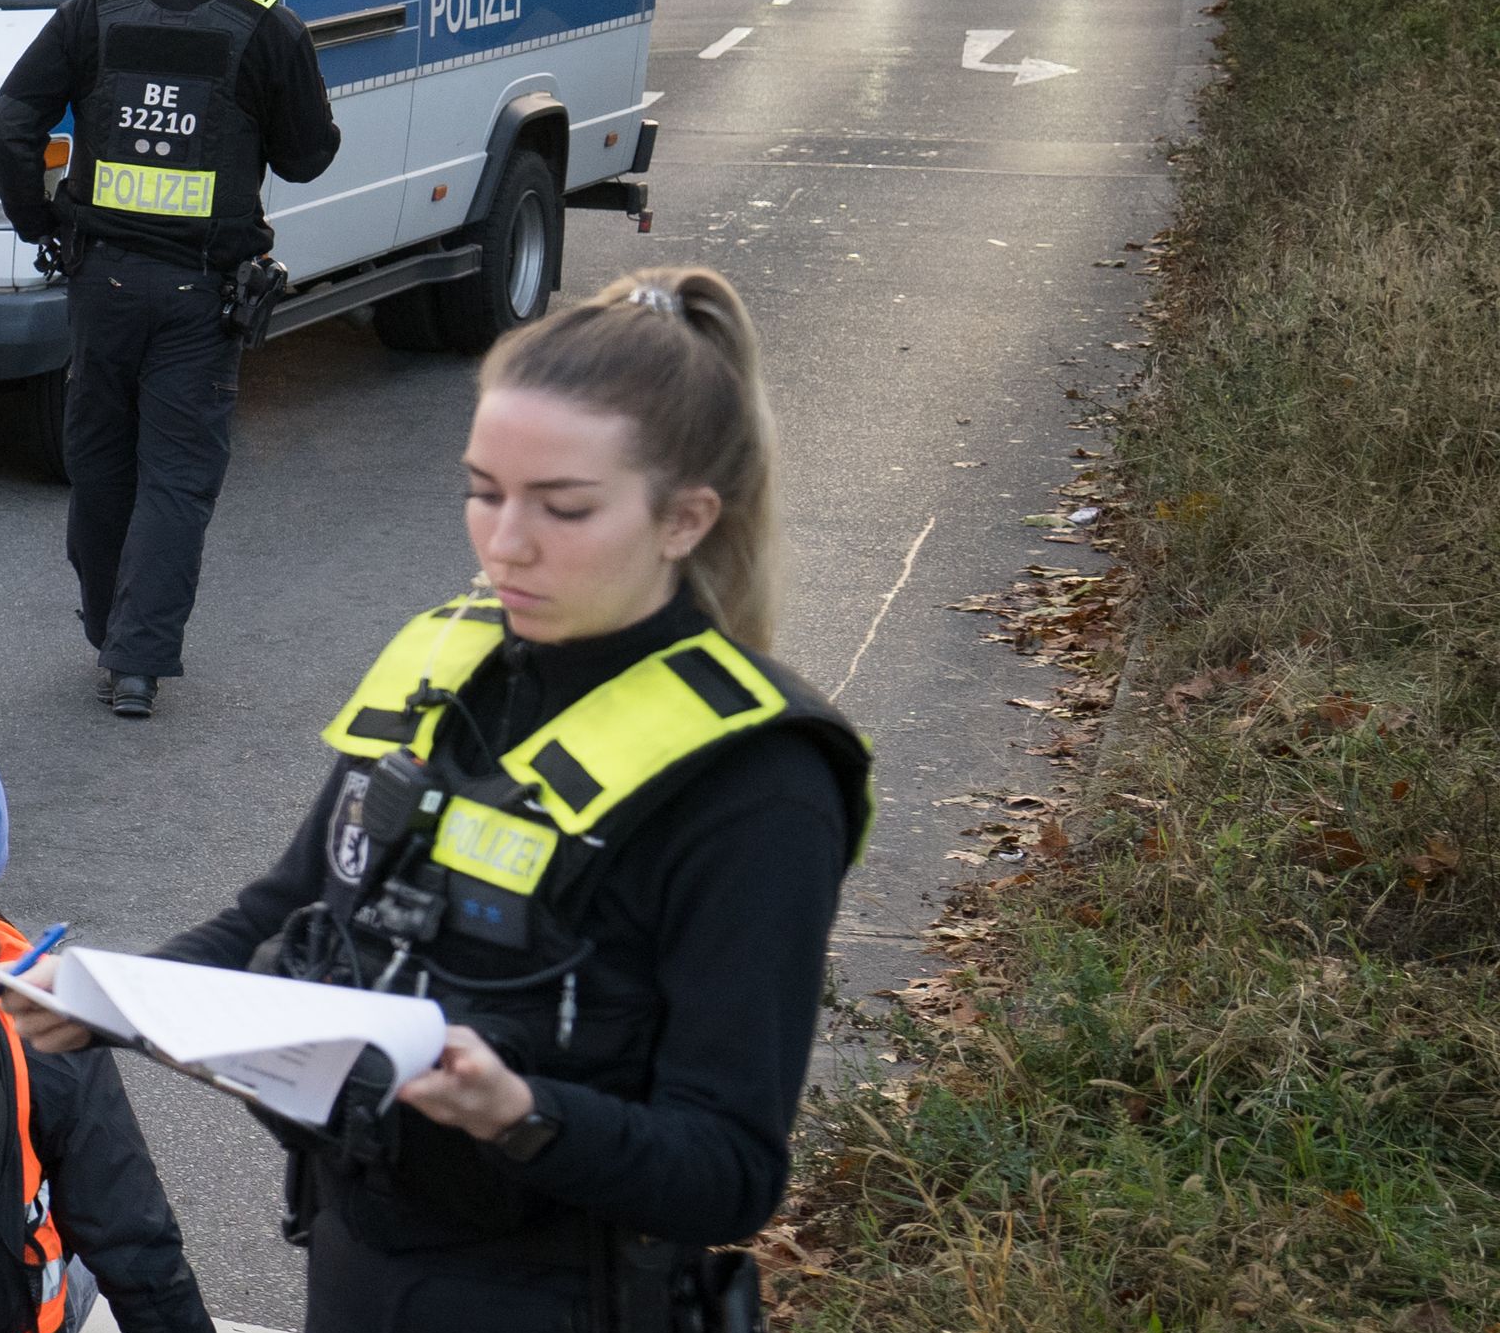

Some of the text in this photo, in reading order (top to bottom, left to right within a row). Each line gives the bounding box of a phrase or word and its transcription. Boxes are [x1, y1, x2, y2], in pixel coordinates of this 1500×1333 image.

[143, 83, 180, 108] BE
[118, 106, 197, 135] 32210
[96, 165, 211, 213] POLIZEI
[445, 807, 545, 877] POLIZEI
